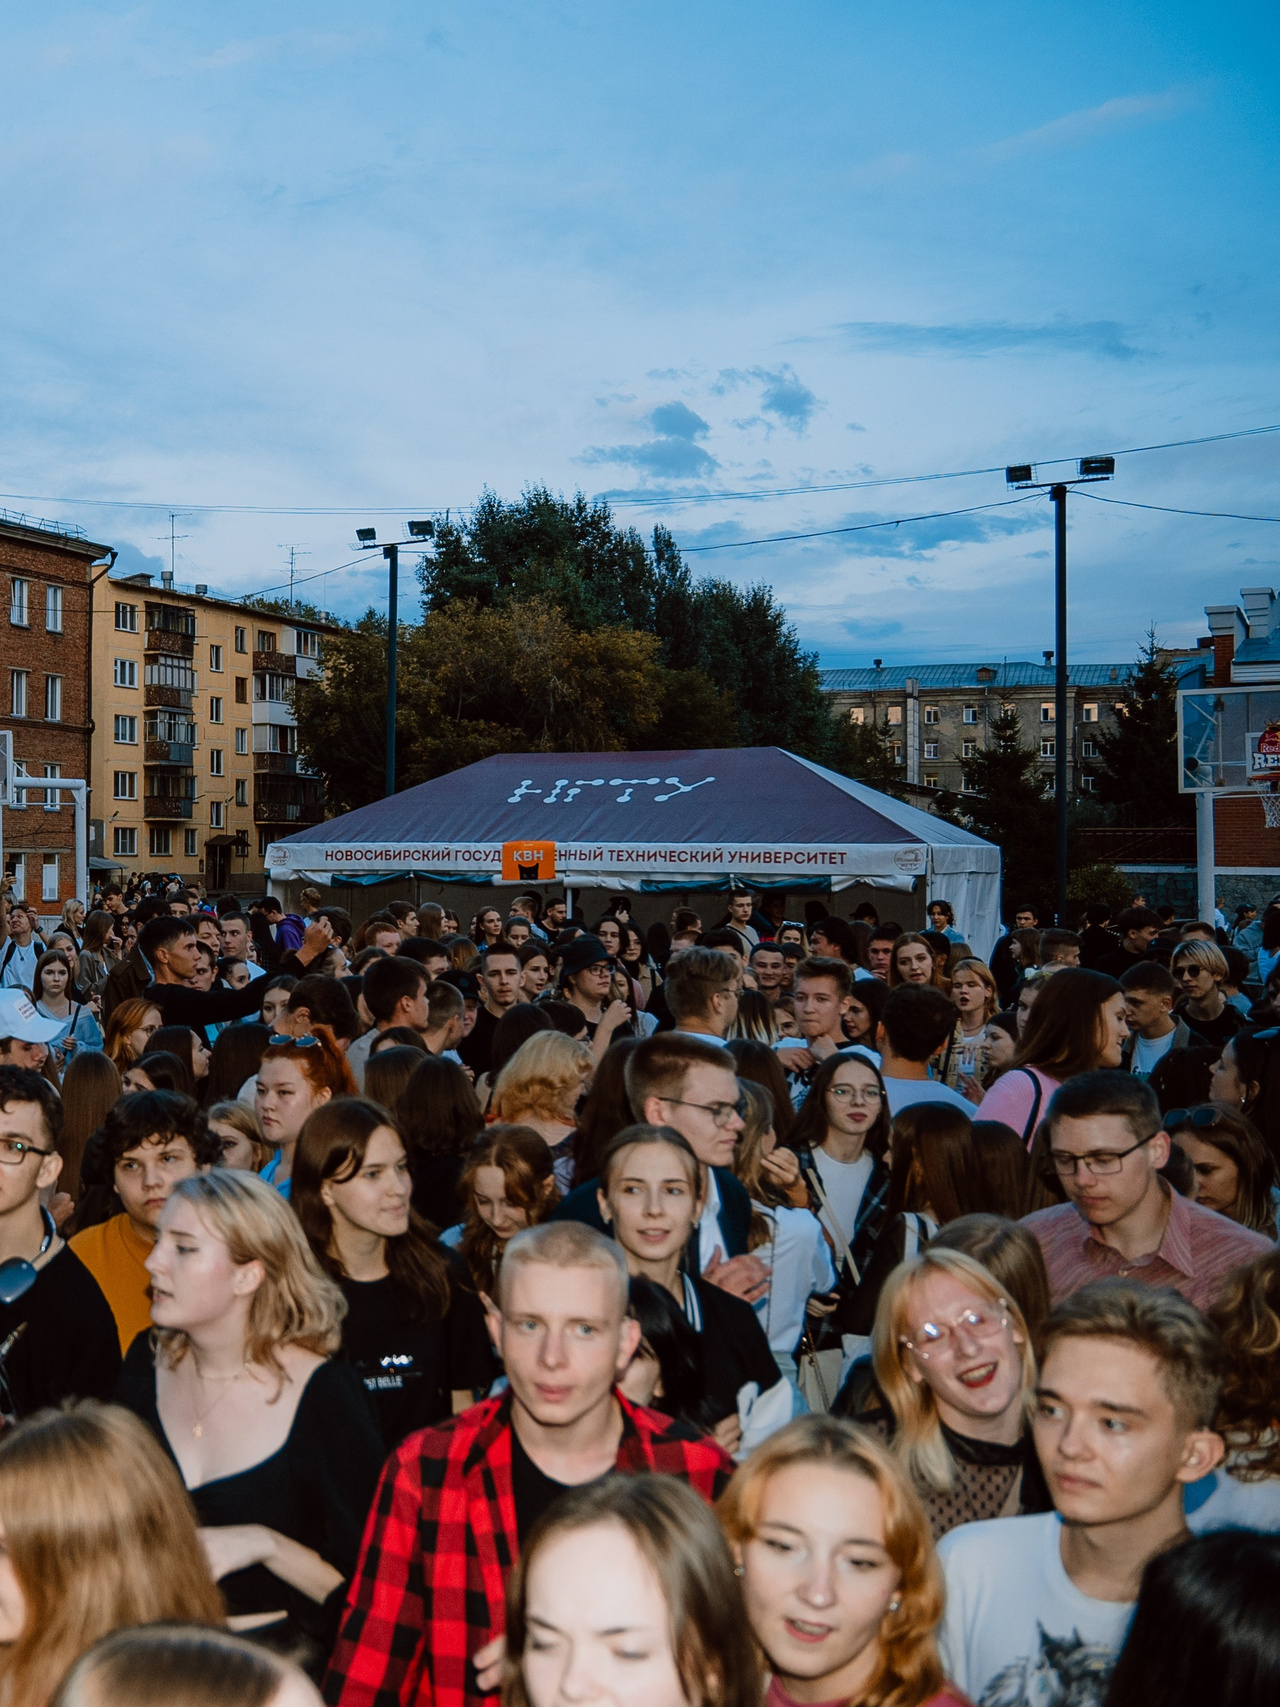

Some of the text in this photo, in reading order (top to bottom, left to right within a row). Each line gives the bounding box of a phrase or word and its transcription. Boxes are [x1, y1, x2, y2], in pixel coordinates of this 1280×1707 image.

[1252, 752, 1280, 770] RE
[325, 847, 451, 862] НОВОСИБИРСКИЙ
[608, 848, 724, 863] ТЕХНИЧЕСКИЙ
[728, 850, 847, 865] УНИВЕРСИТЕТ
[513, 850, 544, 862] КВН
